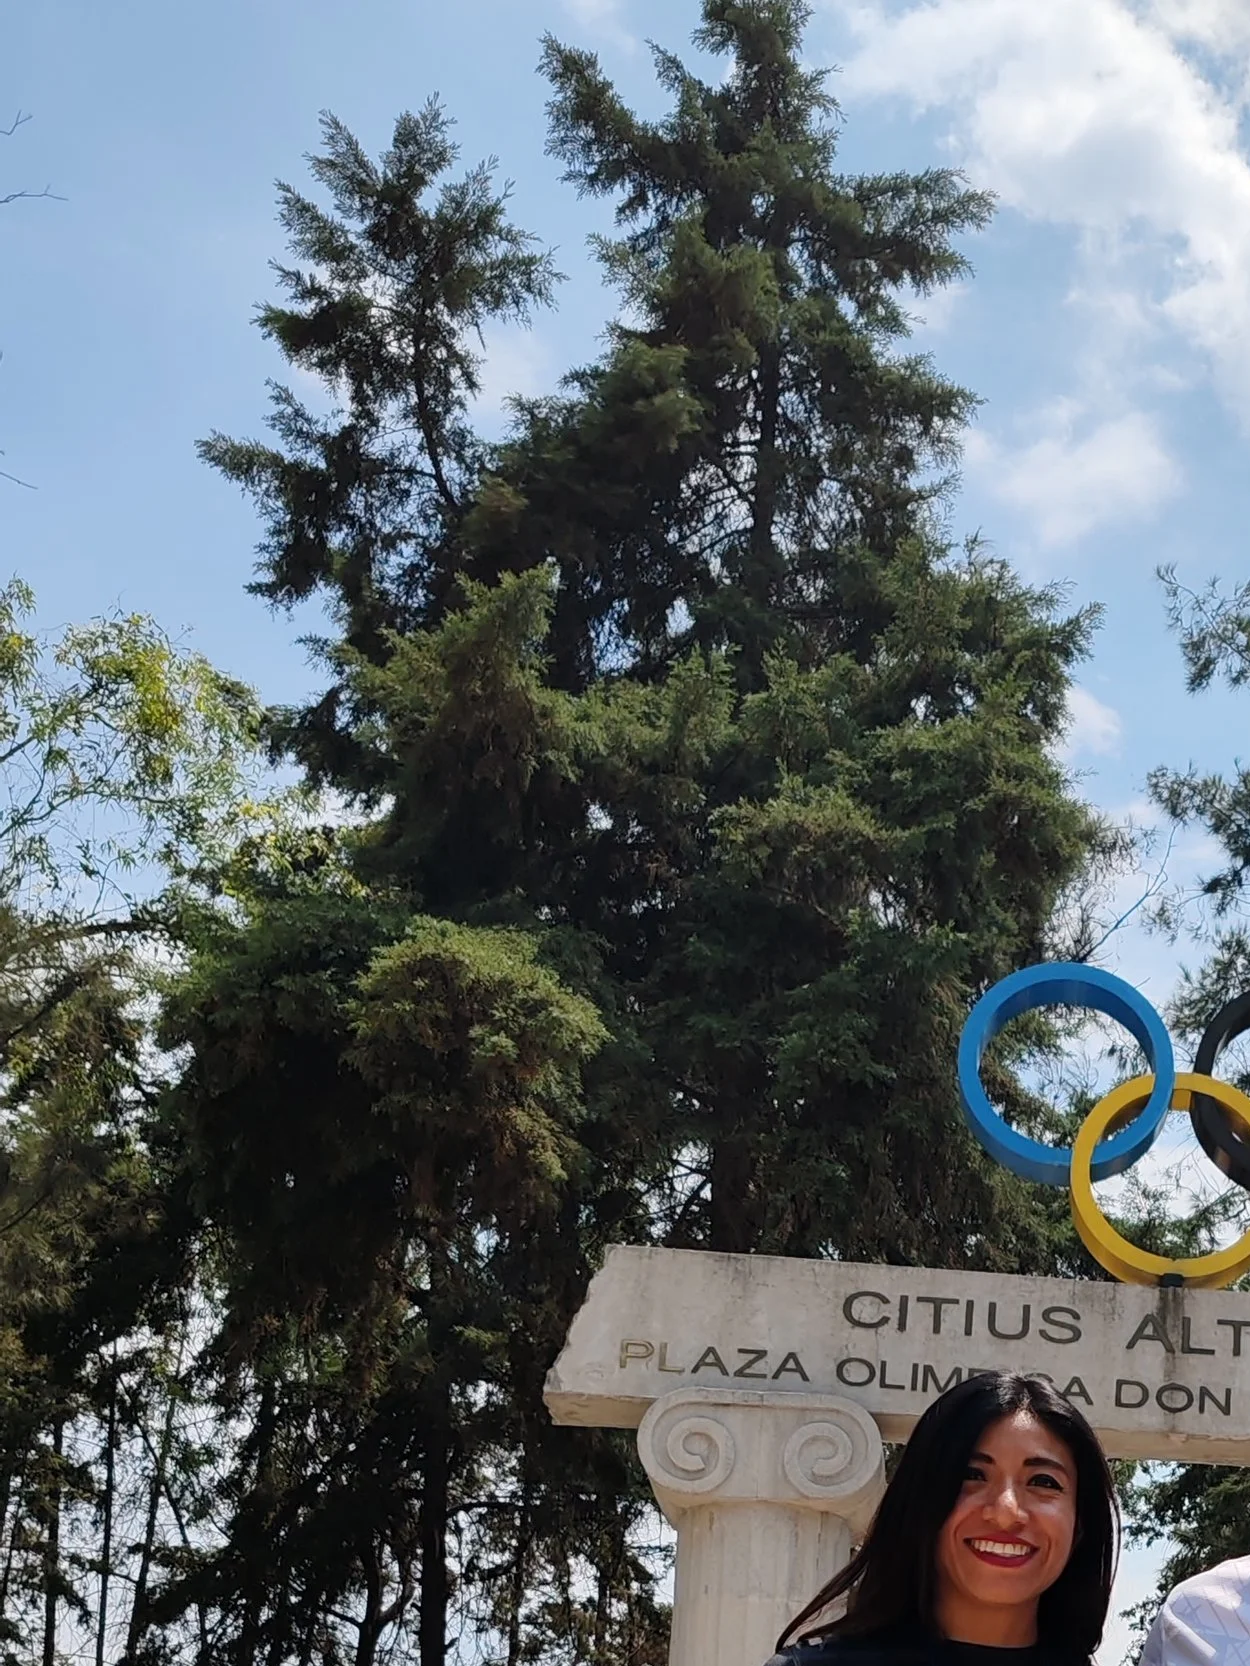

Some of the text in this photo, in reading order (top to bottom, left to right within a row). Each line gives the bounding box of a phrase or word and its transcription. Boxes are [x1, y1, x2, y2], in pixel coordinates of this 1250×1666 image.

[843, 1290, 1083, 1344] CITIUS
[619, 1338, 811, 1382] PLAZA
[836, 1357, 1094, 1406] OLIMA
[1115, 1378, 1232, 1416] DON
